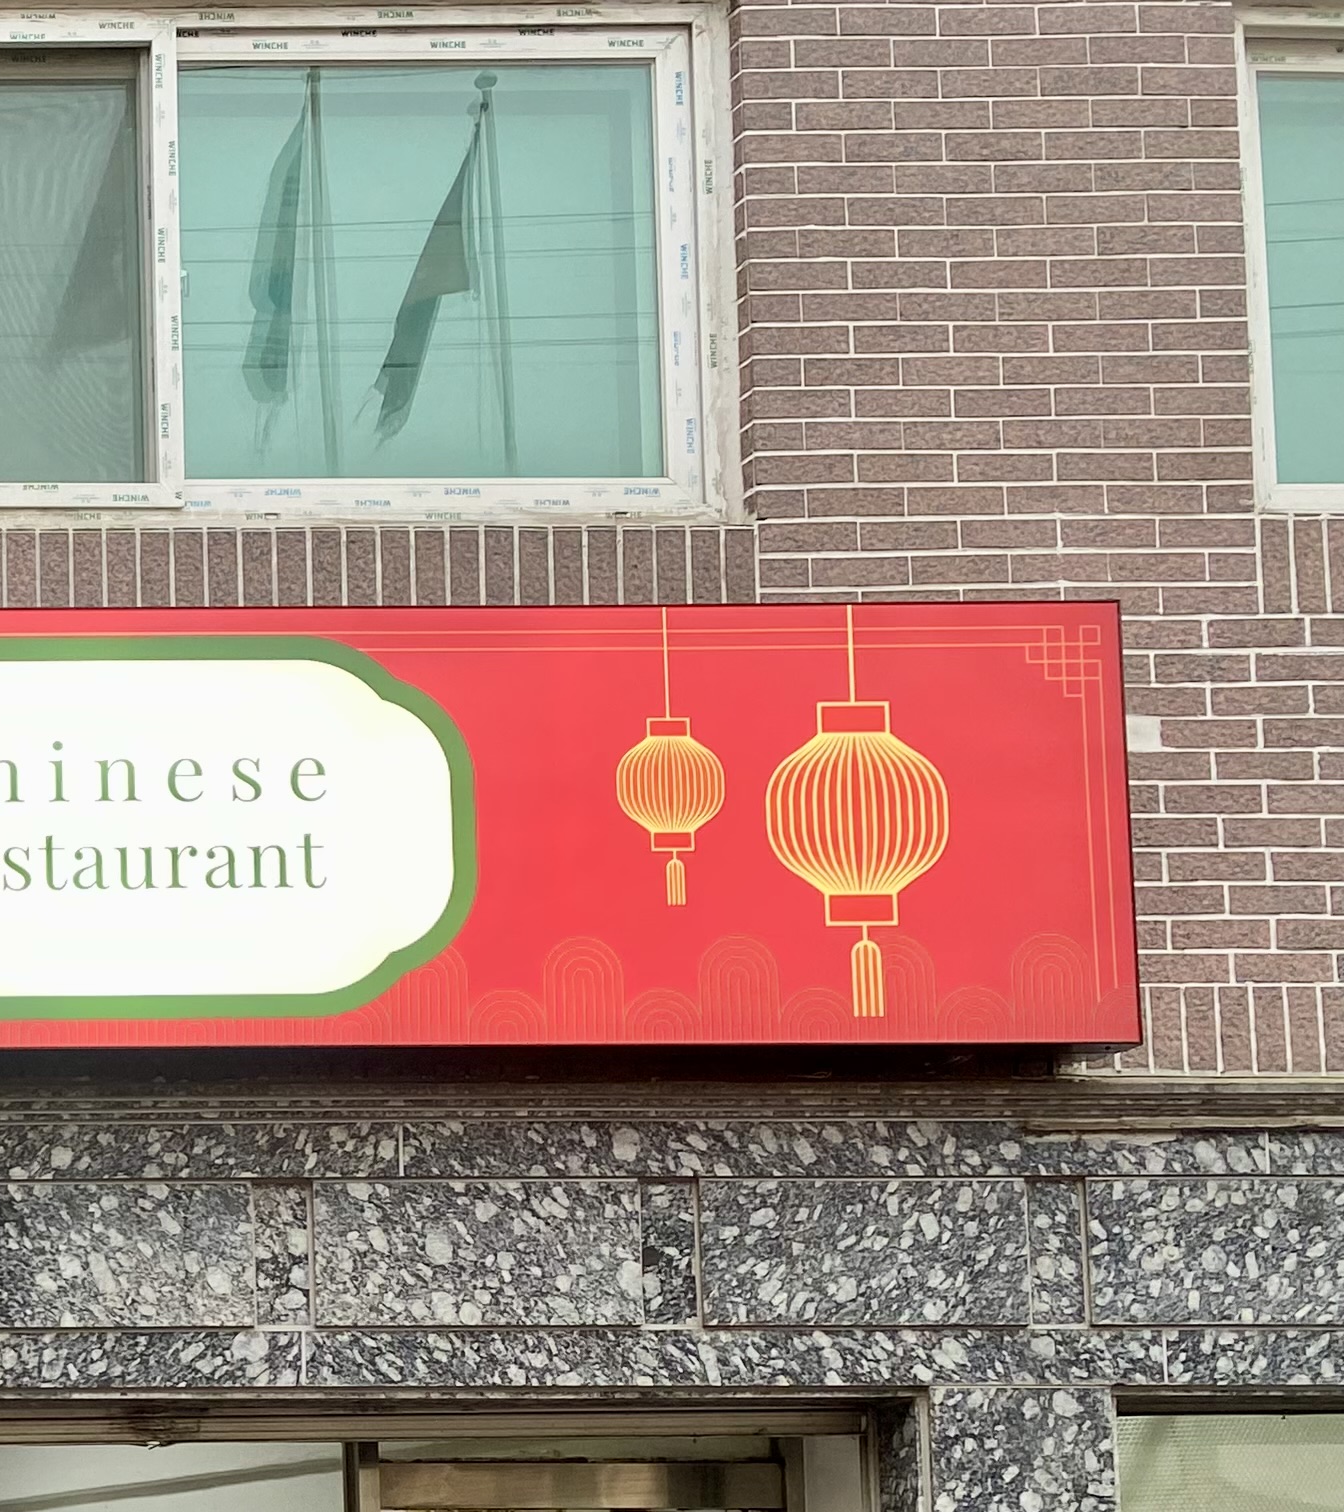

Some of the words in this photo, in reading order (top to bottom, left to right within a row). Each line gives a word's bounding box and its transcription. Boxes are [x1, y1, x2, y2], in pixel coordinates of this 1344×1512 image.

[99, 22, 134, 30] WINCHE
[199, 12, 234, 20] WINCHE
[252, 42, 288, 50] WINCHE
[675, 72, 683, 106] WINCHE
[168, 140, 176, 176] WINCHE
[704, 160, 712, 194] WINCHE
[680, 244, 688, 280] WINCHE
[171, 316, 179, 351] WINCHE
[161, 403, 169, 438] WINCHE
[686, 418, 694, 454] WINCHE
[113, 494, 149, 502] WINCHE
[444, 488, 480, 496] WINCHE
[624, 488, 660, 496] WINCHE
[425, 512, 461, 520] WINCHE
